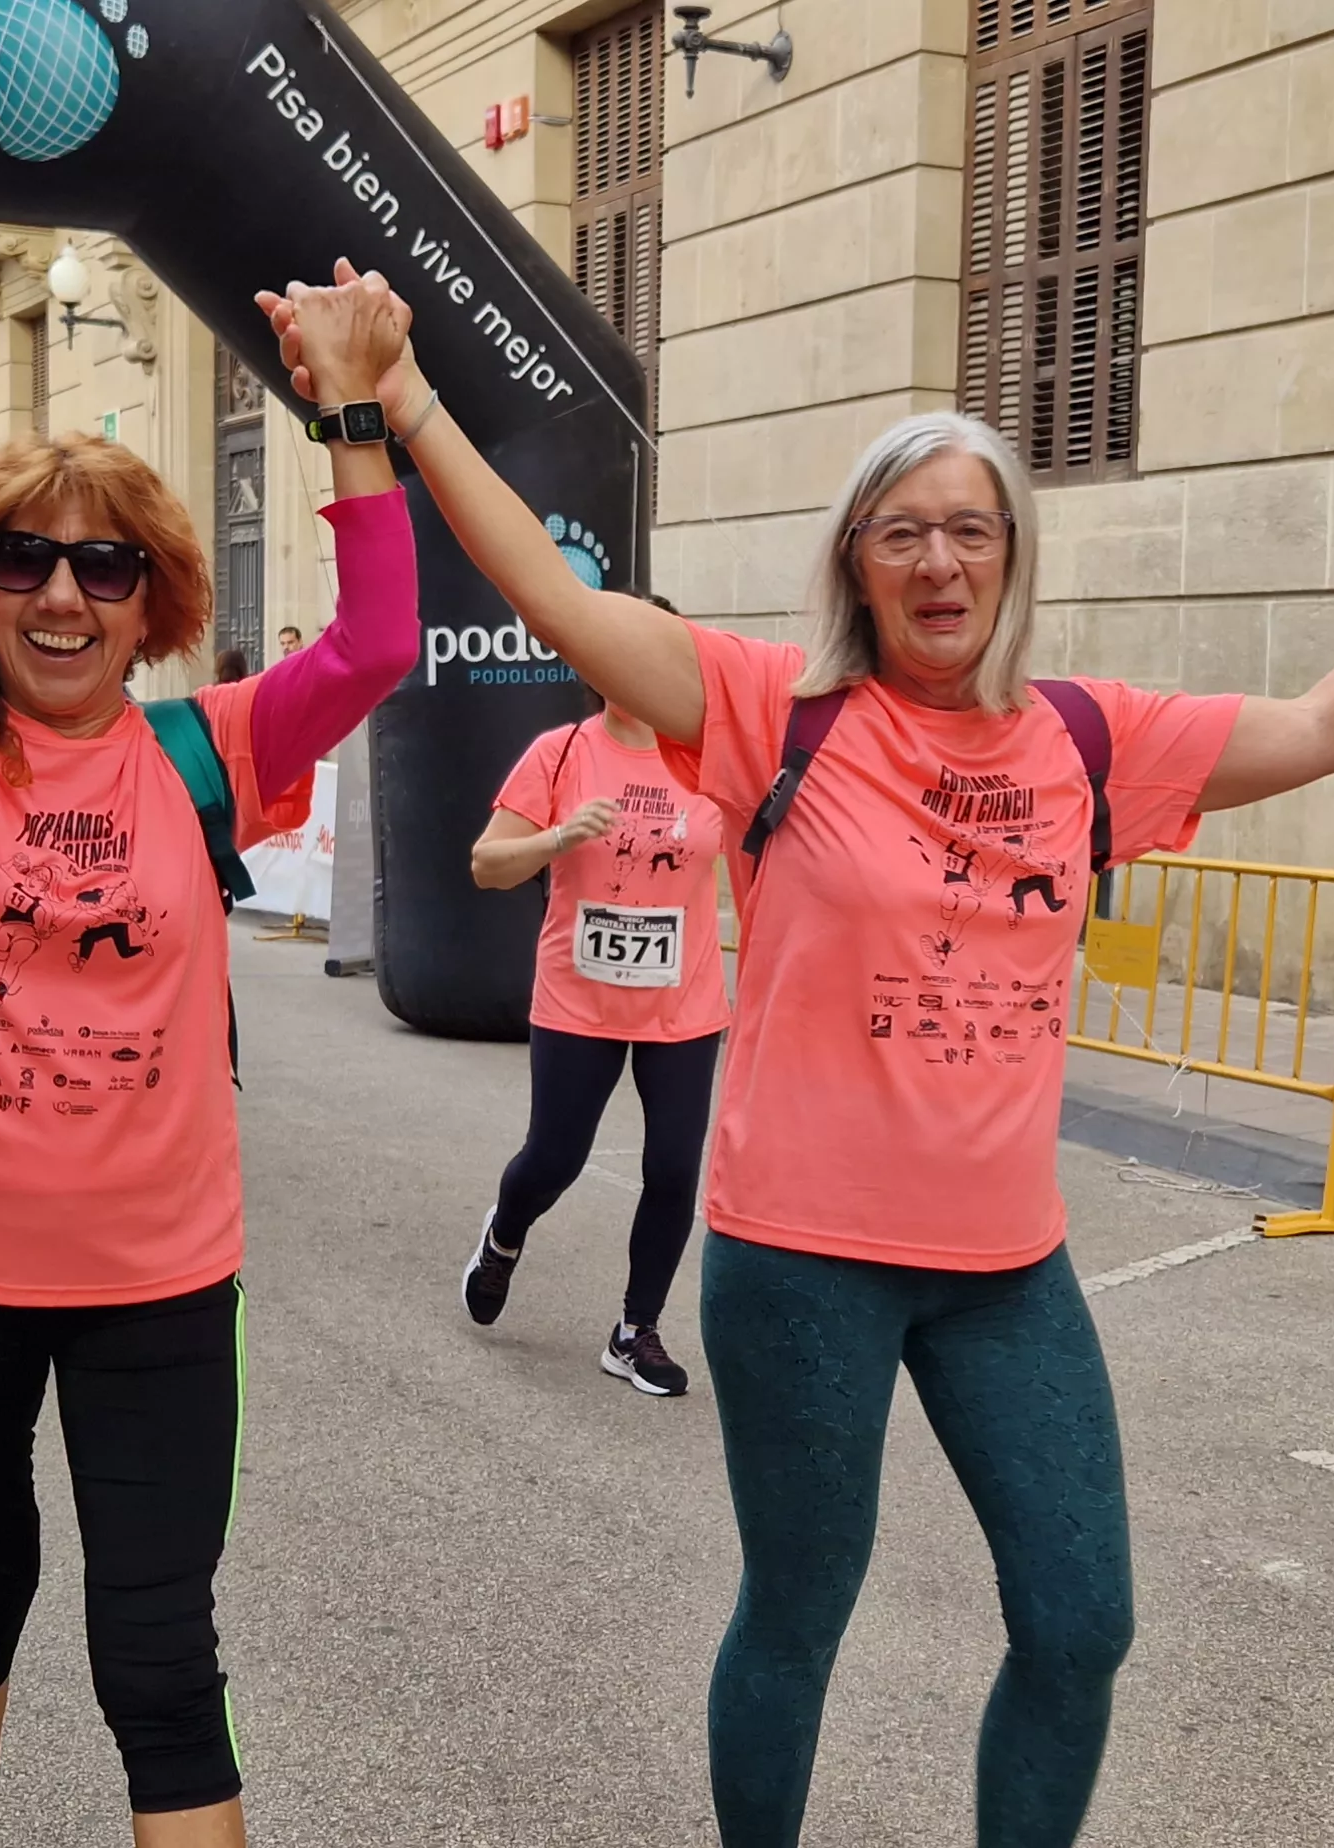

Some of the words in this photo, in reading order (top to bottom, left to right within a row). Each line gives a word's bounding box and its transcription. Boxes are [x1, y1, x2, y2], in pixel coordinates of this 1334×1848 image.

[246, 44, 324, 142] Pisa
[323, 131, 400, 238] bien,
[410, 228, 475, 305] vive
[473, 301, 573, 401] mejor
[471, 664, 578, 684] PODOLOGÍA
[623, 783, 669, 801] CORRAMOS
[631, 799, 641, 813] LA
[642, 800, 675, 815] CIENCIA
[953, 794, 974, 823] LA
[976, 788, 1034, 823] CIENCIA
[590, 916, 625, 931] CONTRA
[627, 922, 637, 931] EL
[638, 920, 673, 932] CÁNCER
[587, 930, 669, 964] 1571
[63, 1048, 102, 1058] URBAN
